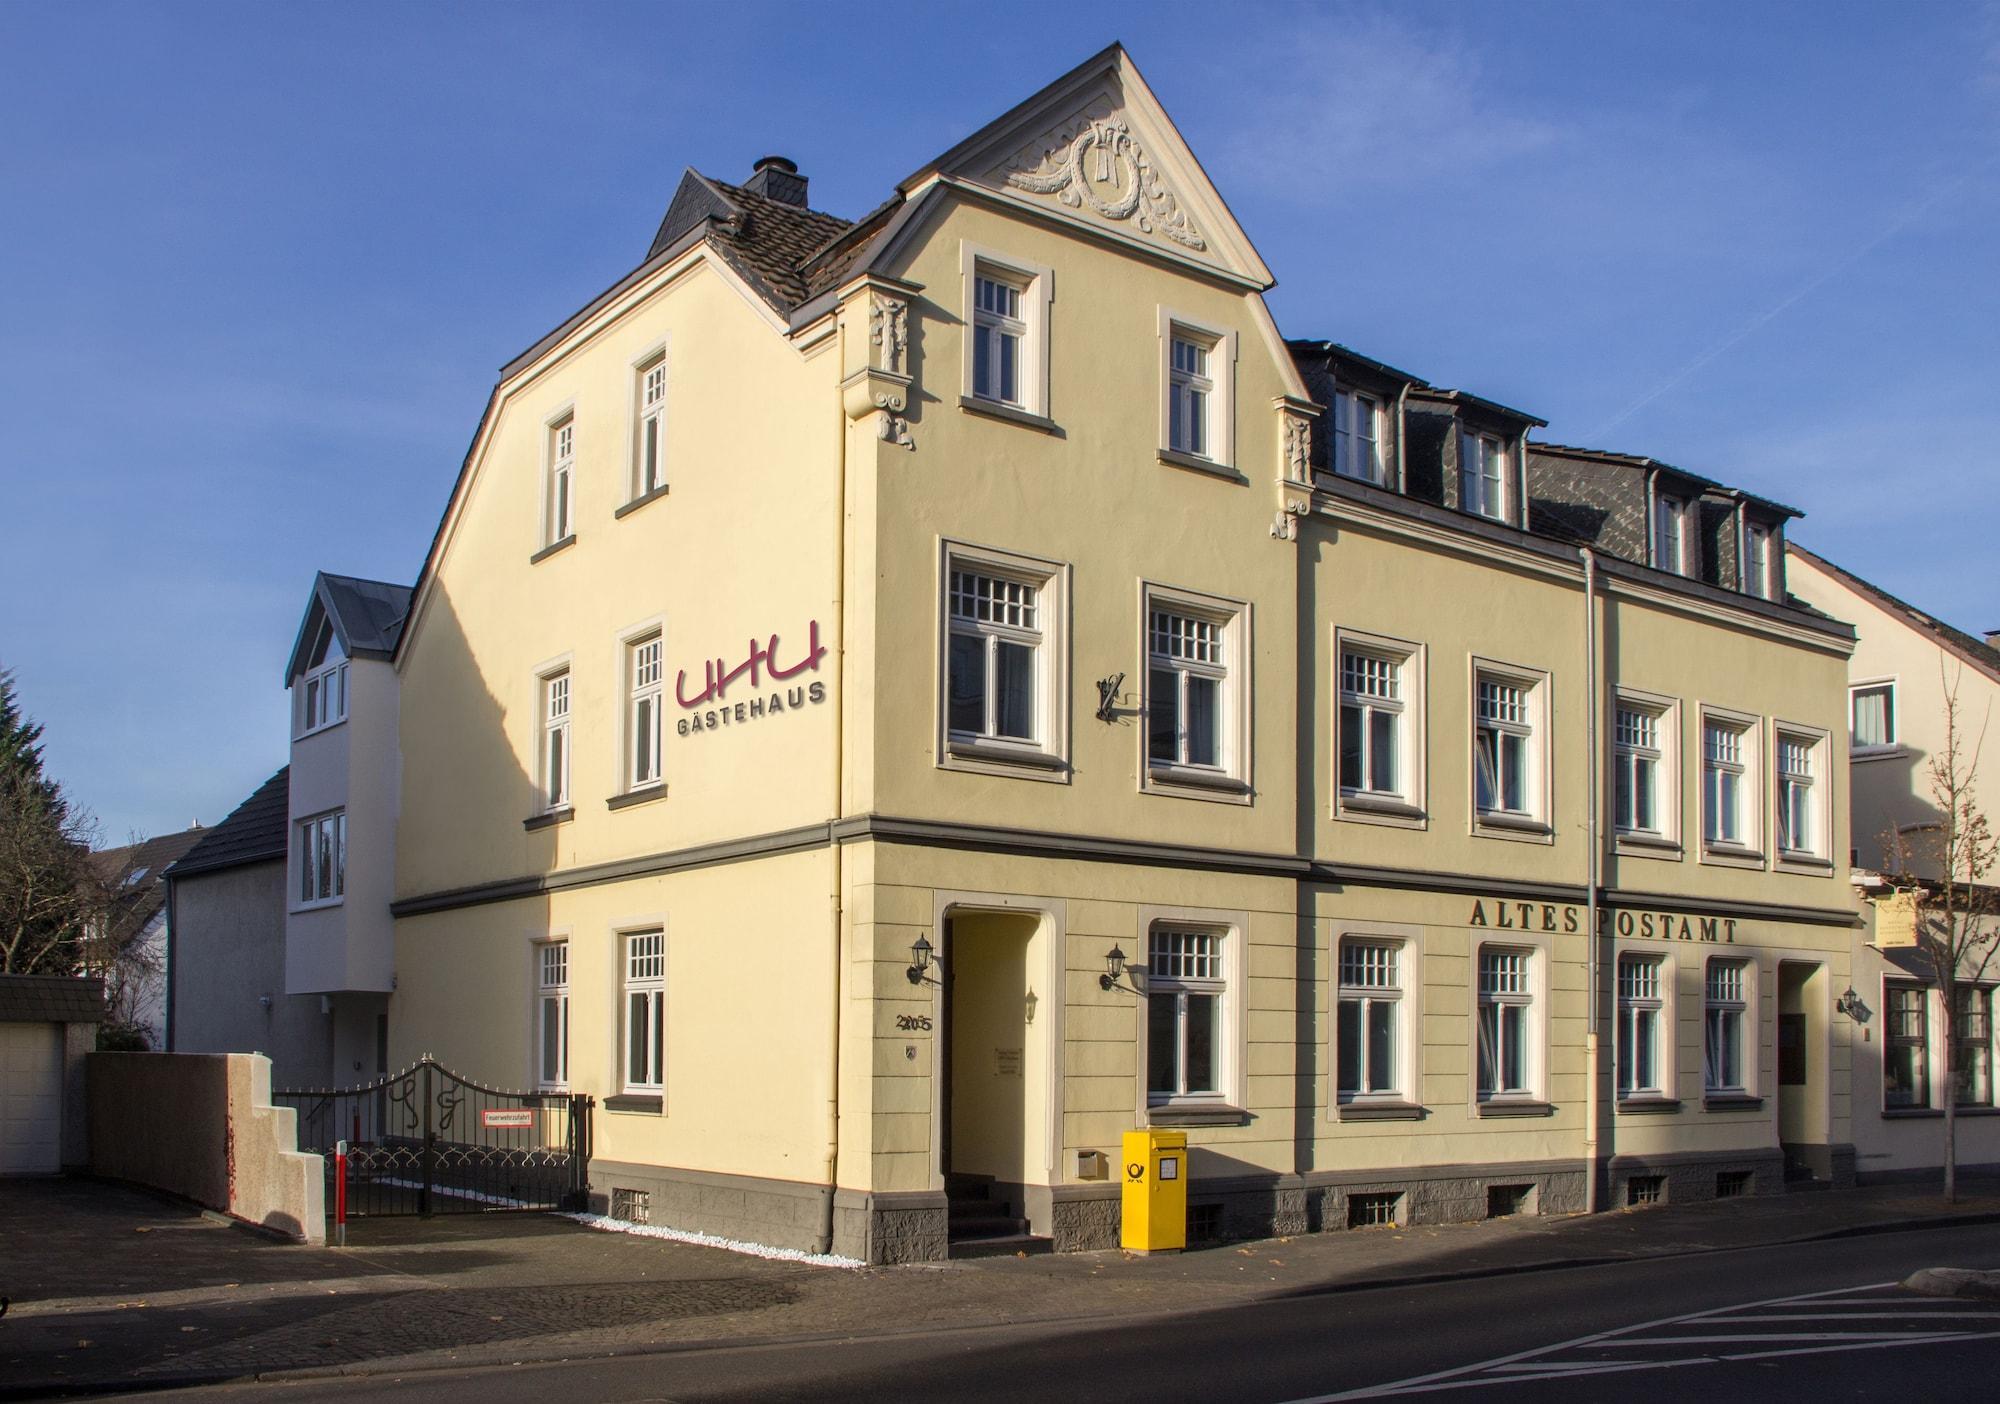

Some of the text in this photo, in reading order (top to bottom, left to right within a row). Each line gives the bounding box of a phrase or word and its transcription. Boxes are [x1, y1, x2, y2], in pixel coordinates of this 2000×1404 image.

[677, 681, 824, 735] GÄSTEHAUS
[1470, 899, 1736, 942] ALTES POSTAMT
